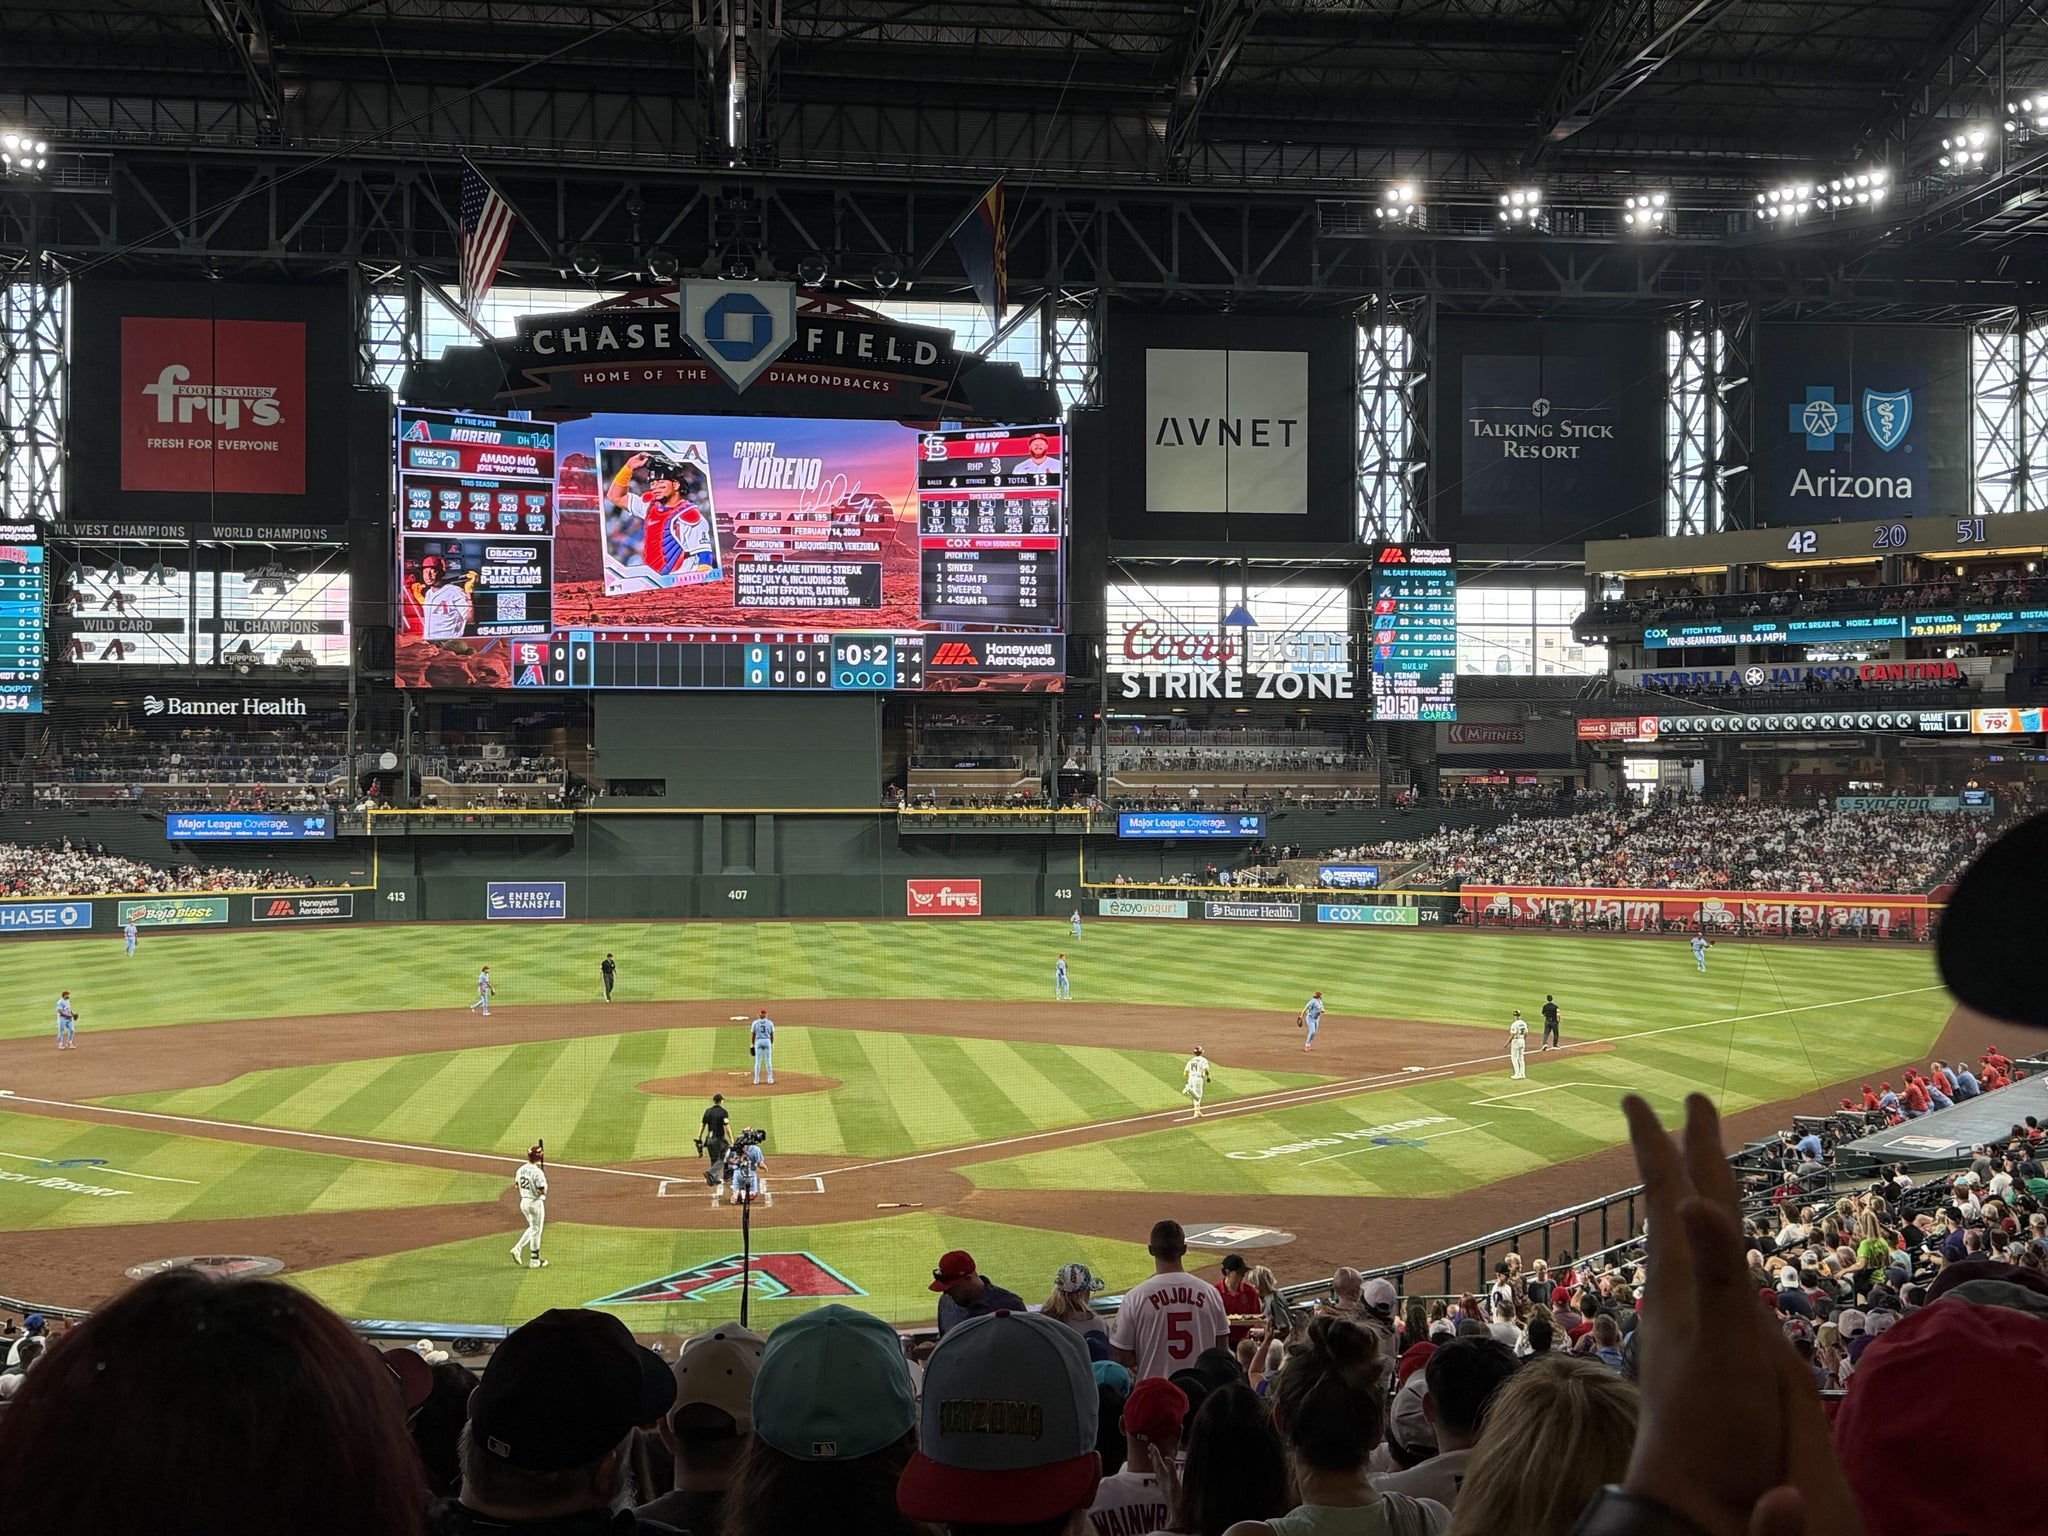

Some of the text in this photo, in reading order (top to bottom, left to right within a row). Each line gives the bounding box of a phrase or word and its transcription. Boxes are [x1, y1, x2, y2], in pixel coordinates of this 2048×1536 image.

[533, 324, 937, 365] CHASE FIELD
[584, 368, 890, 391] HOME OF THE DIAMONDBACKS
[178, 386, 271, 396] FOOD STORES
[142, 365, 280, 429] fry's
[450, 429, 501, 444] MORENO
[1156, 418, 1297, 447] AVNET
[147, 438, 278, 451] FRESH FOR EVERYONE
[531, 432, 550, 449] 14
[733, 442, 775, 458] GABRIEL
[974, 442, 999, 454] MAY
[480, 453, 515, 465] AMADO
[967, 463, 983, 471] RHP
[738, 458, 822, 490] MORENO
[1033, 474, 1047, 486] 13
[1790, 469, 1912, 498] Arizona
[410, 500, 430, 508] .304
[470, 503, 489, 511] .442
[530, 505, 541, 513] 73
[1004, 508, 1023, 516] 4.50
[411, 520, 429, 528] 279
[474, 522, 486, 530] 32
[929, 525, 944, 533] 23%
[978, 525, 995, 533] 45%
[1005, 524, 1023, 533] .253
[55, 525, 185, 536] NL WEST CHAMPIONS
[213, 527, 327, 539] WORLD CHAMPIONS
[794, 527, 830, 536] FEBRUARY
[1873, 524, 1907, 548] 20
[1957, 519, 1985, 543] 51
[946, 539, 971, 547] COX
[1788, 531, 1816, 553] 42
[1410, 548, 1449, 557] Honeywell
[1410, 556, 1452, 565] Aerospace
[481, 566, 541, 575] STREAM
[739, 564, 862, 575] HAS HITTING STREAK
[947, 564, 973, 572] SINKER
[516, 576, 542, 584] GAMES
[739, 575, 846, 585] SINCE JULY INCLUDING SIX
[947, 575, 976, 583] 4-SEAM
[739, 586, 849, 596] MULTI-HIT BATTING
[947, 586, 982, 594] SWEEPER
[779, 597, 816, 606] OPS WITH
[83, 620, 153, 631] WILD CARD
[224, 621, 319, 633] NL CHAMPIONS
[1645, 612, 2013, 638] COX PITCH TYPE SPEED LAUNCH ANGLE
[1911, 625, 1933, 635] 79.9
[1936, 624, 1962, 634] MPH
[813, 634, 829, 643] LOB
[1123, 619, 1353, 662] Coors LIGHT
[1667, 632, 1786, 646] FOUR-SEAM FASTBALL 98.4 MPH
[846, 645, 887, 665] 0 2
[985, 643, 1052, 656] Honeywell
[555, 648, 805, 663] 0 0 0 0
[985, 654, 1055, 668] Aerospace
[555, 670, 826, 683] 0 0 0 0 0
[1860, 662, 1958, 681] CANTINA
[1122, 671, 1243, 699] STRIKE
[1256, 672, 1353, 699] ZONE
[167, 697, 307, 715] Banner Health
[1423, 712, 1451, 720] CARES
[1920, 714, 1943, 722] GAME
[1920, 716, 1962, 731] TOTAL 1
[1985, 719, 2007, 729] 79¢
[1482, 731, 1524, 740] FITNESS
[1610, 727, 1636, 735] METER
[178, 819, 289, 830] Major League Coverage.
[1130, 818, 1226, 828] Major League Coverage.
[1334, 871, 1376, 879] PRESIDENTIAL
[387, 891, 405, 902] 413
[509, 892, 551, 900] ENERGY
[728, 890, 747, 900] 407
[937, 886, 978, 908] fry's
[1055, 889, 1072, 899] 413
[300, 899, 338, 908] Honeywell
[509, 900, 561, 909] TRANSFER
[300, 907, 339, 916] Aerospace
[1224, 906, 1293, 918] Banner Health
[1330, 908, 1406, 922] COX COX
[1421, 911, 1439, 921] 374
[1332, 1116, 1456, 1139] ARIZONA
[520, 1177, 530, 1190] 22
[1149, 1287, 1206, 1311] PUJOLS
[1167, 1312, 1193, 1360] 5
